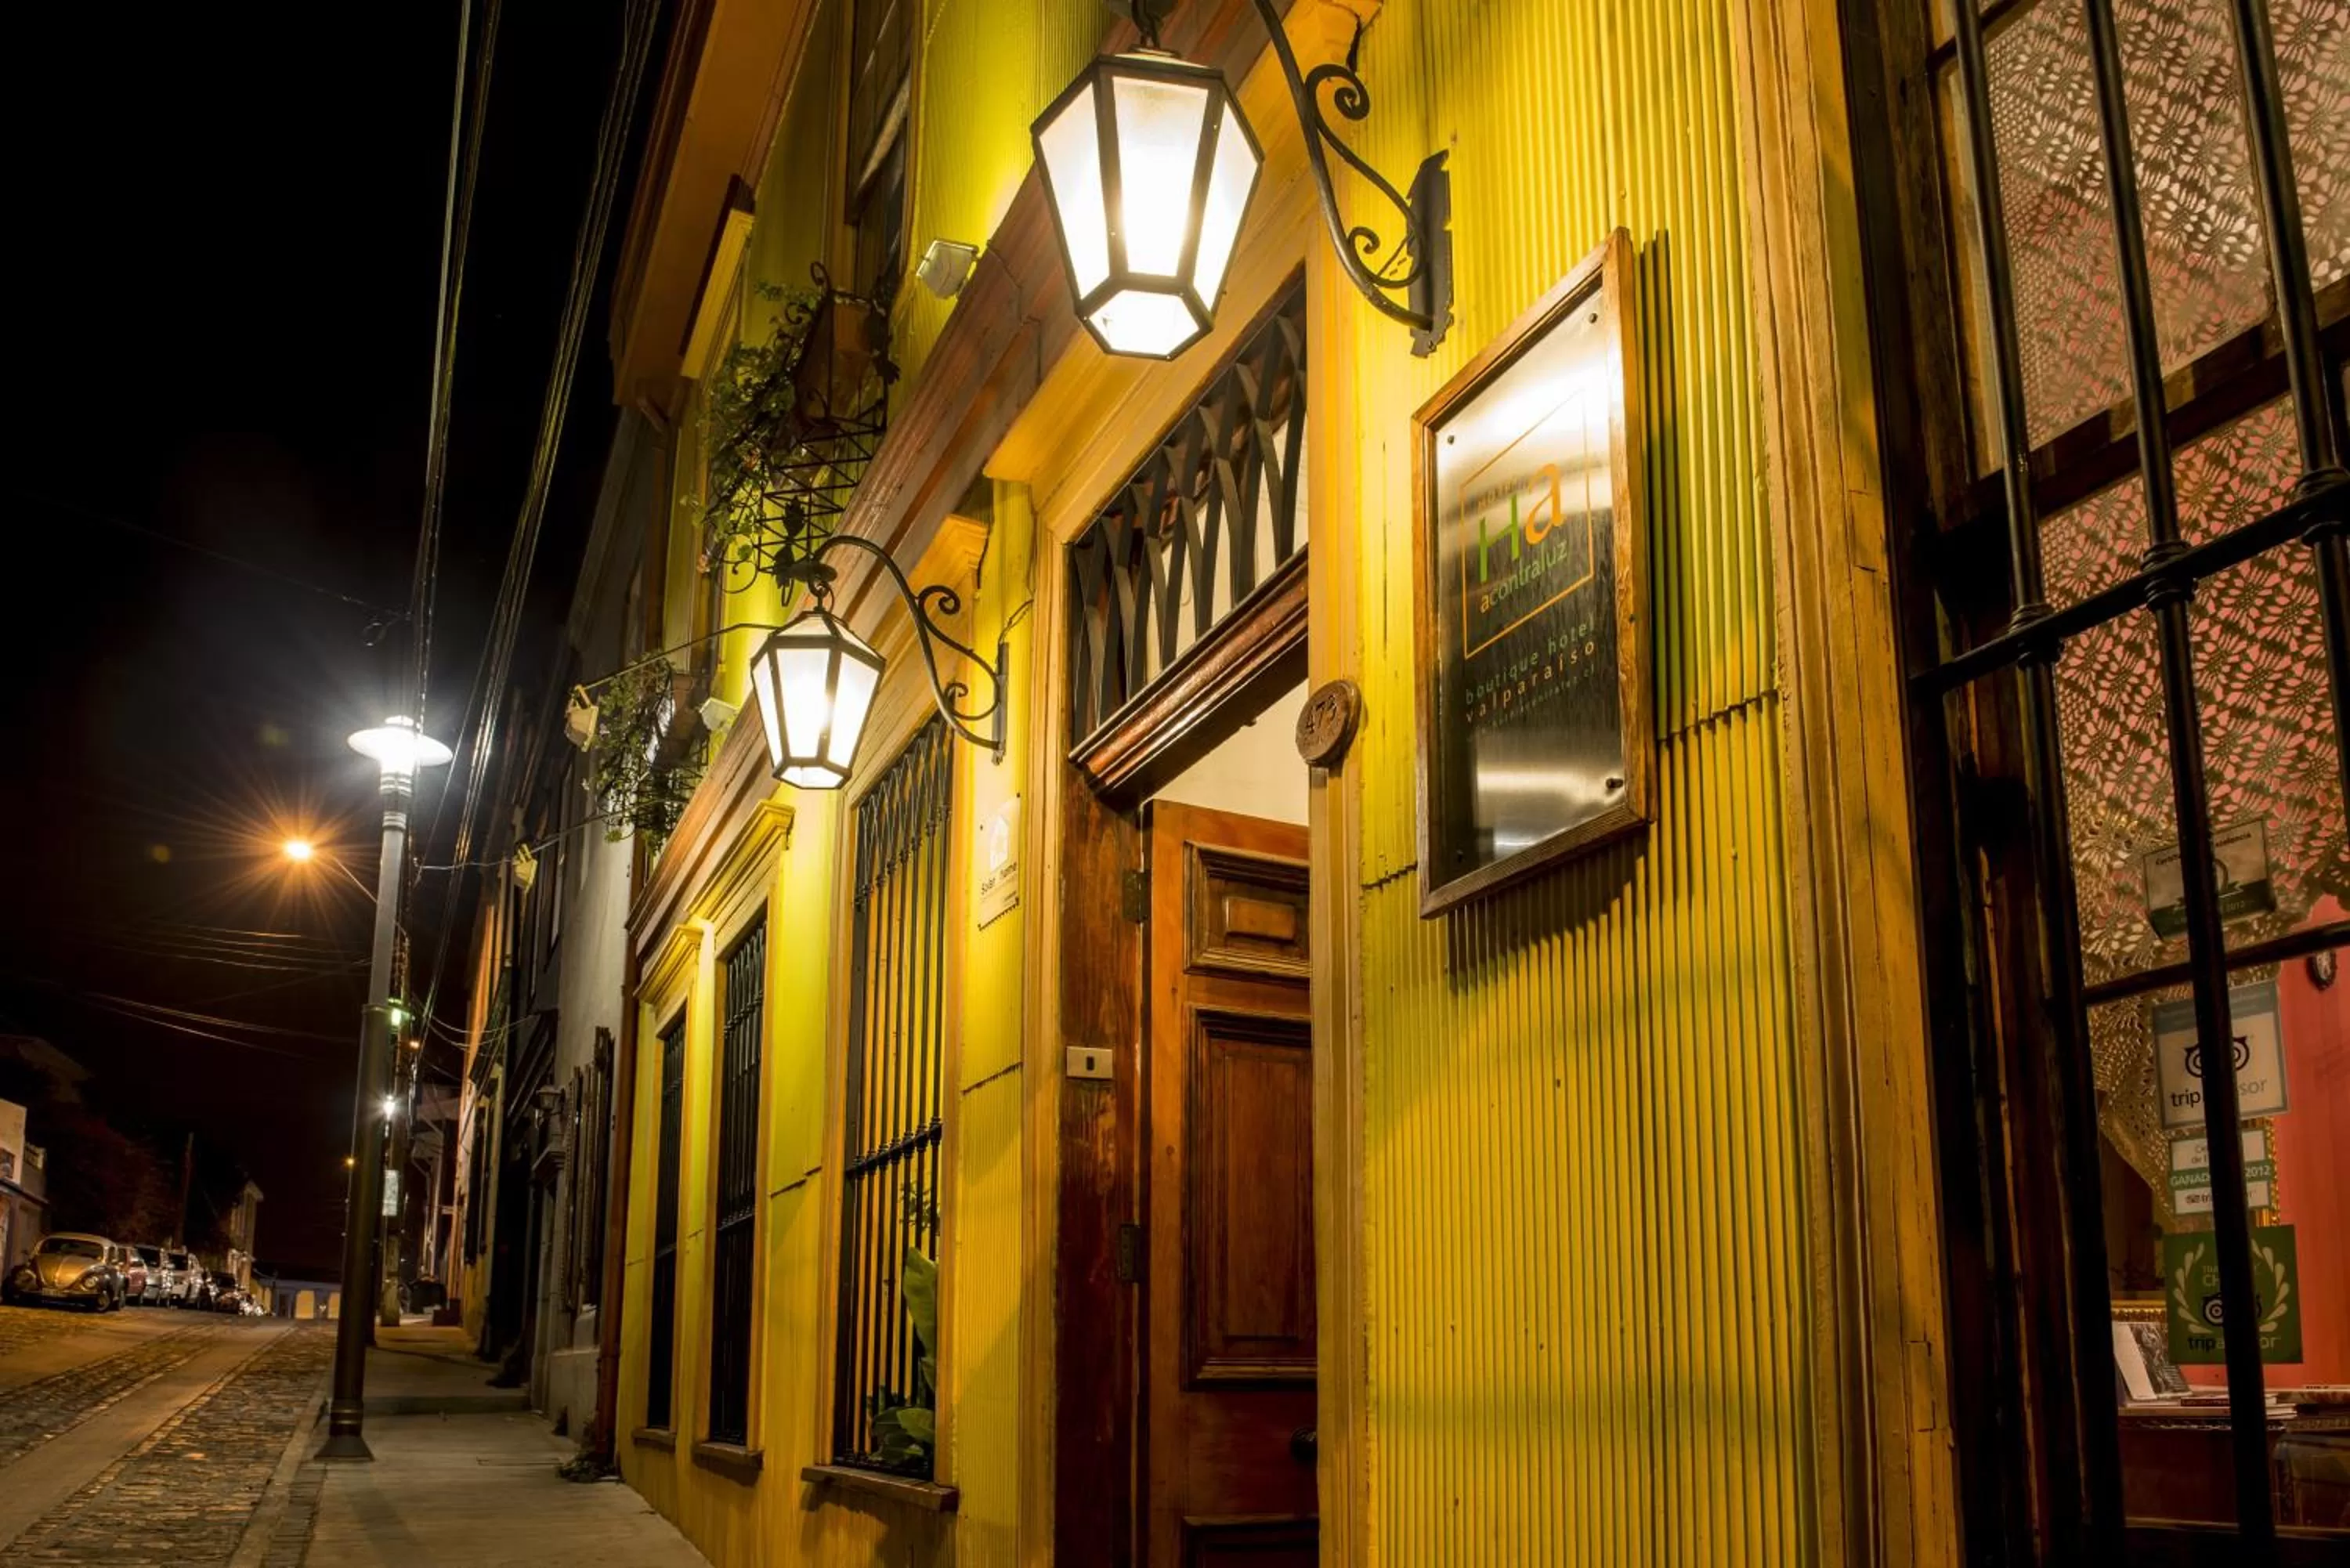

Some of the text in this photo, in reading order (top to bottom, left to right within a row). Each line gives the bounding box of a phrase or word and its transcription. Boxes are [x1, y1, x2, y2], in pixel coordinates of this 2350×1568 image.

[1479, 463, 1565, 583] Ha
[1480, 540, 1567, 614] acontraluz
[1465, 651, 1539, 705] boutique
[1547, 611, 1595, 656] hotel
[1466, 640, 1595, 724] valparaiso
